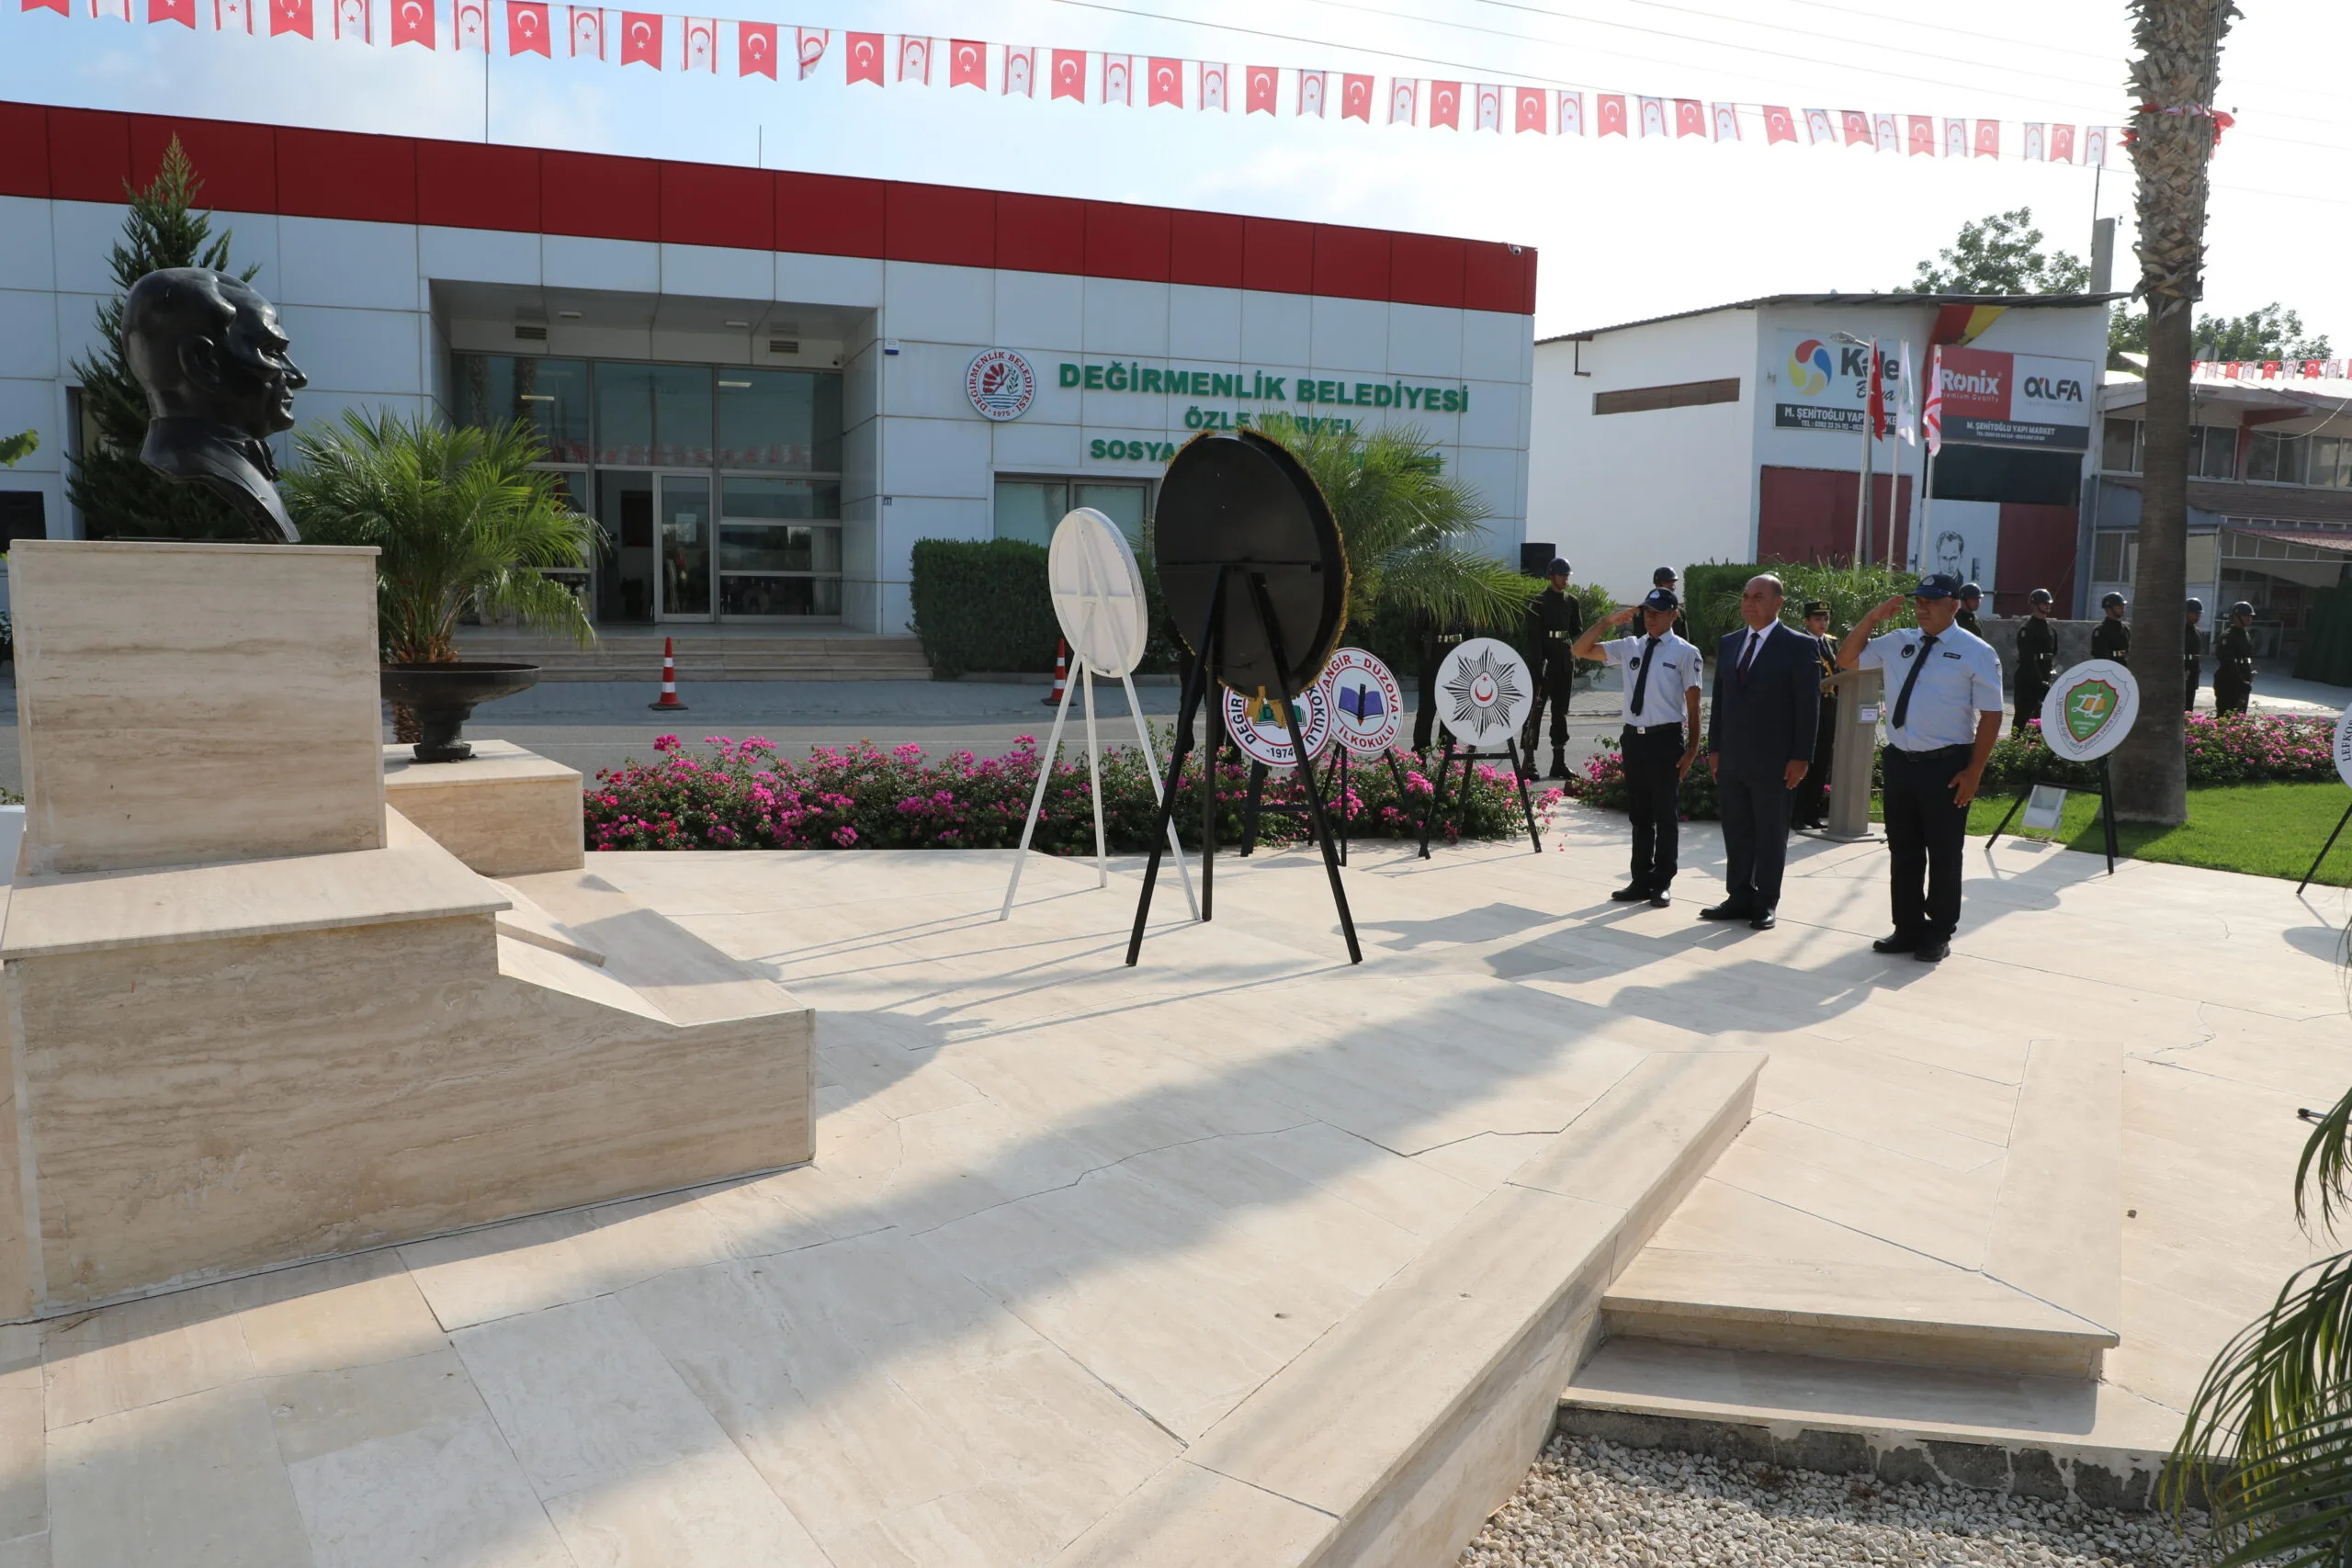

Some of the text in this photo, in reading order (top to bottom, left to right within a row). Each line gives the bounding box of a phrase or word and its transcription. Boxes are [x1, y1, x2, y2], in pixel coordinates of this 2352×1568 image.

[1059, 360, 1468, 412] DEĞİRMENLİK BELEDİYESİ
[1941, 369, 1999, 395] Ronix
[1784, 407, 1794, 418] M.
[1797, 407, 1845, 422] ŞEHİTOĞLU
[1847, 413, 1866, 423] YAP
[2013, 425, 2029, 434] YAPI
[2029, 426, 2055, 436] MARKET
[1090, 438, 1185, 462] SOSYA
[1323, 653, 1352, 694] ANGİR
[1305, 685, 1326, 747] KOKULU
